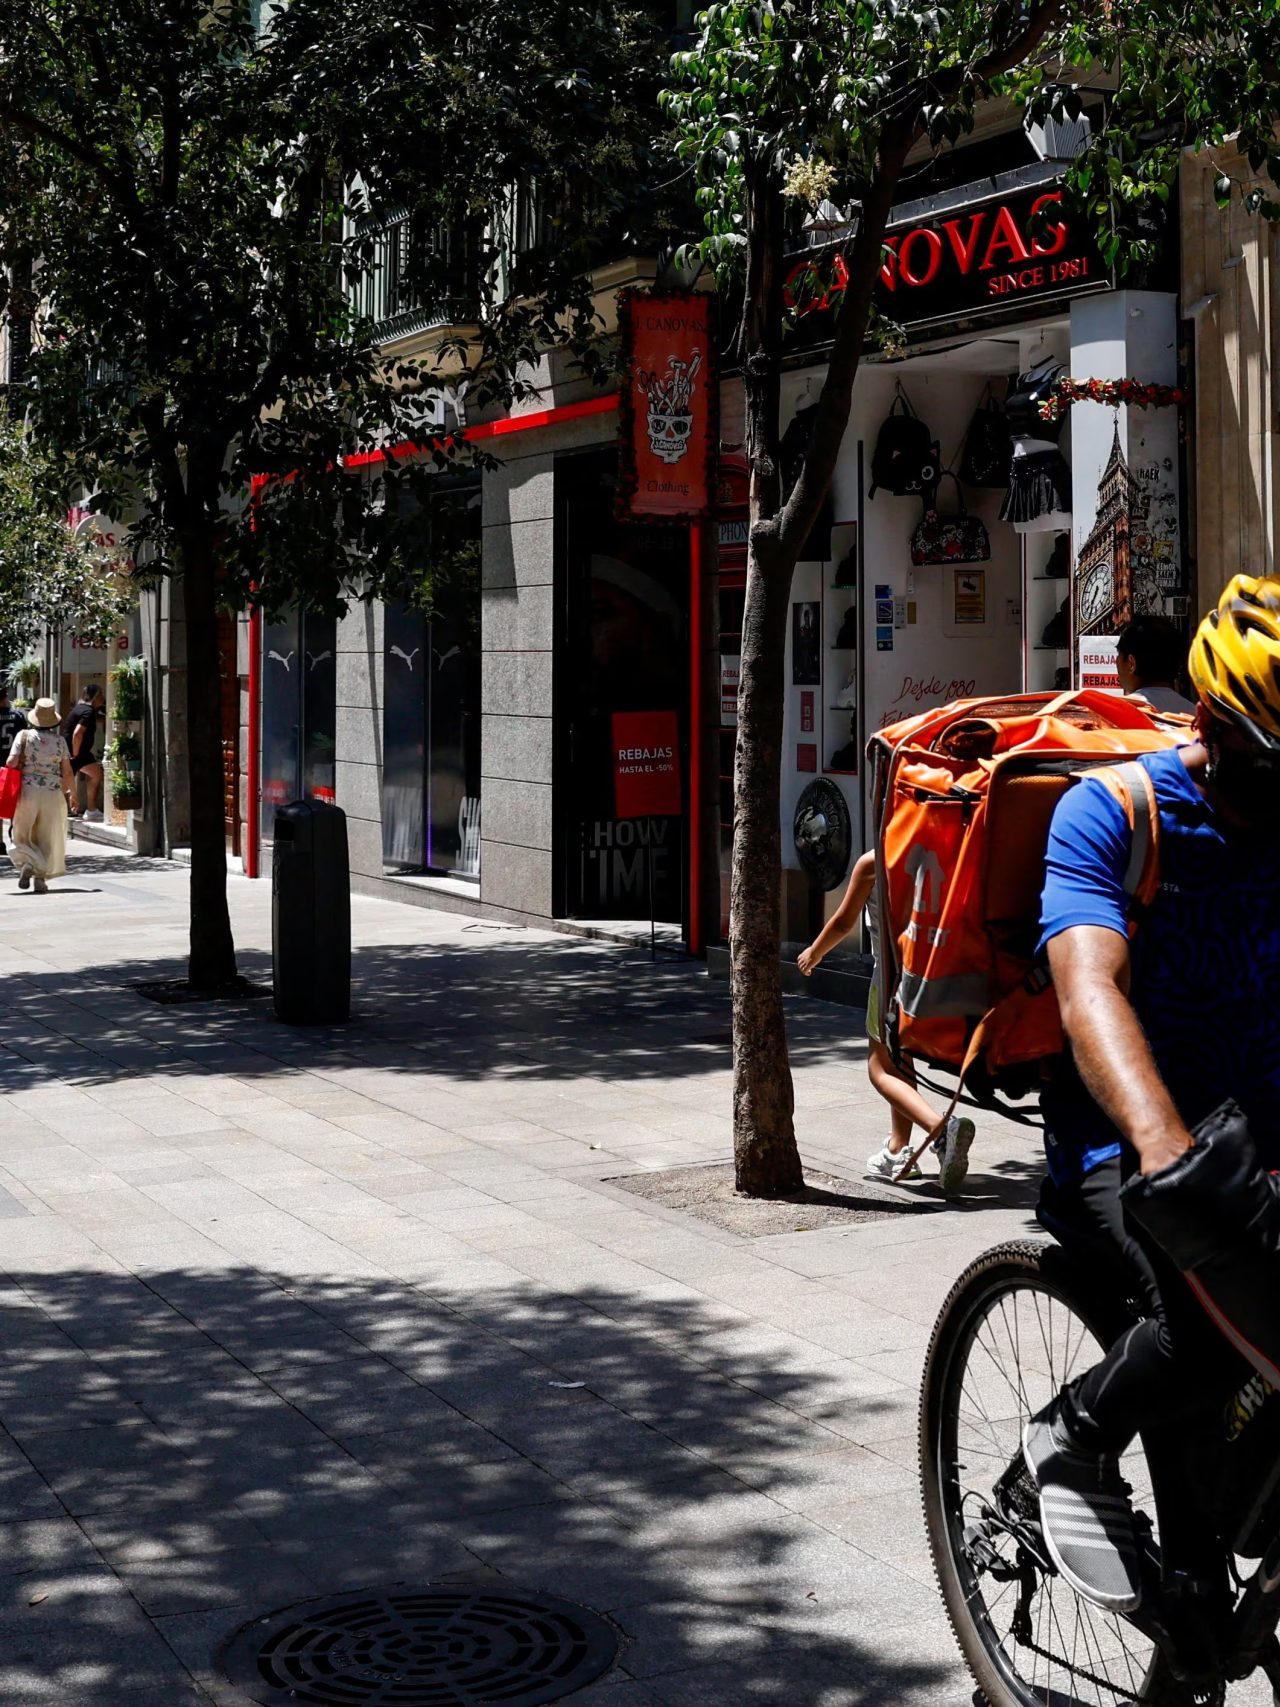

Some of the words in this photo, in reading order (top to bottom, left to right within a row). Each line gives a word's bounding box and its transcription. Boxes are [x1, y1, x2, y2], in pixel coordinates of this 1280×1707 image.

[986, 265, 1045, 298] SINCE
[1050, 256, 1090, 283] 1981
[647, 480, 690, 496] Clothing
[1083, 655, 1118, 665] REBAJA
[619, 748, 673, 761] REBAJAS
[619, 764, 644, 774] HASTA
[645, 764, 654, 772] EL
[589, 819, 669, 847] HOW
[589, 848, 670, 905] IME
